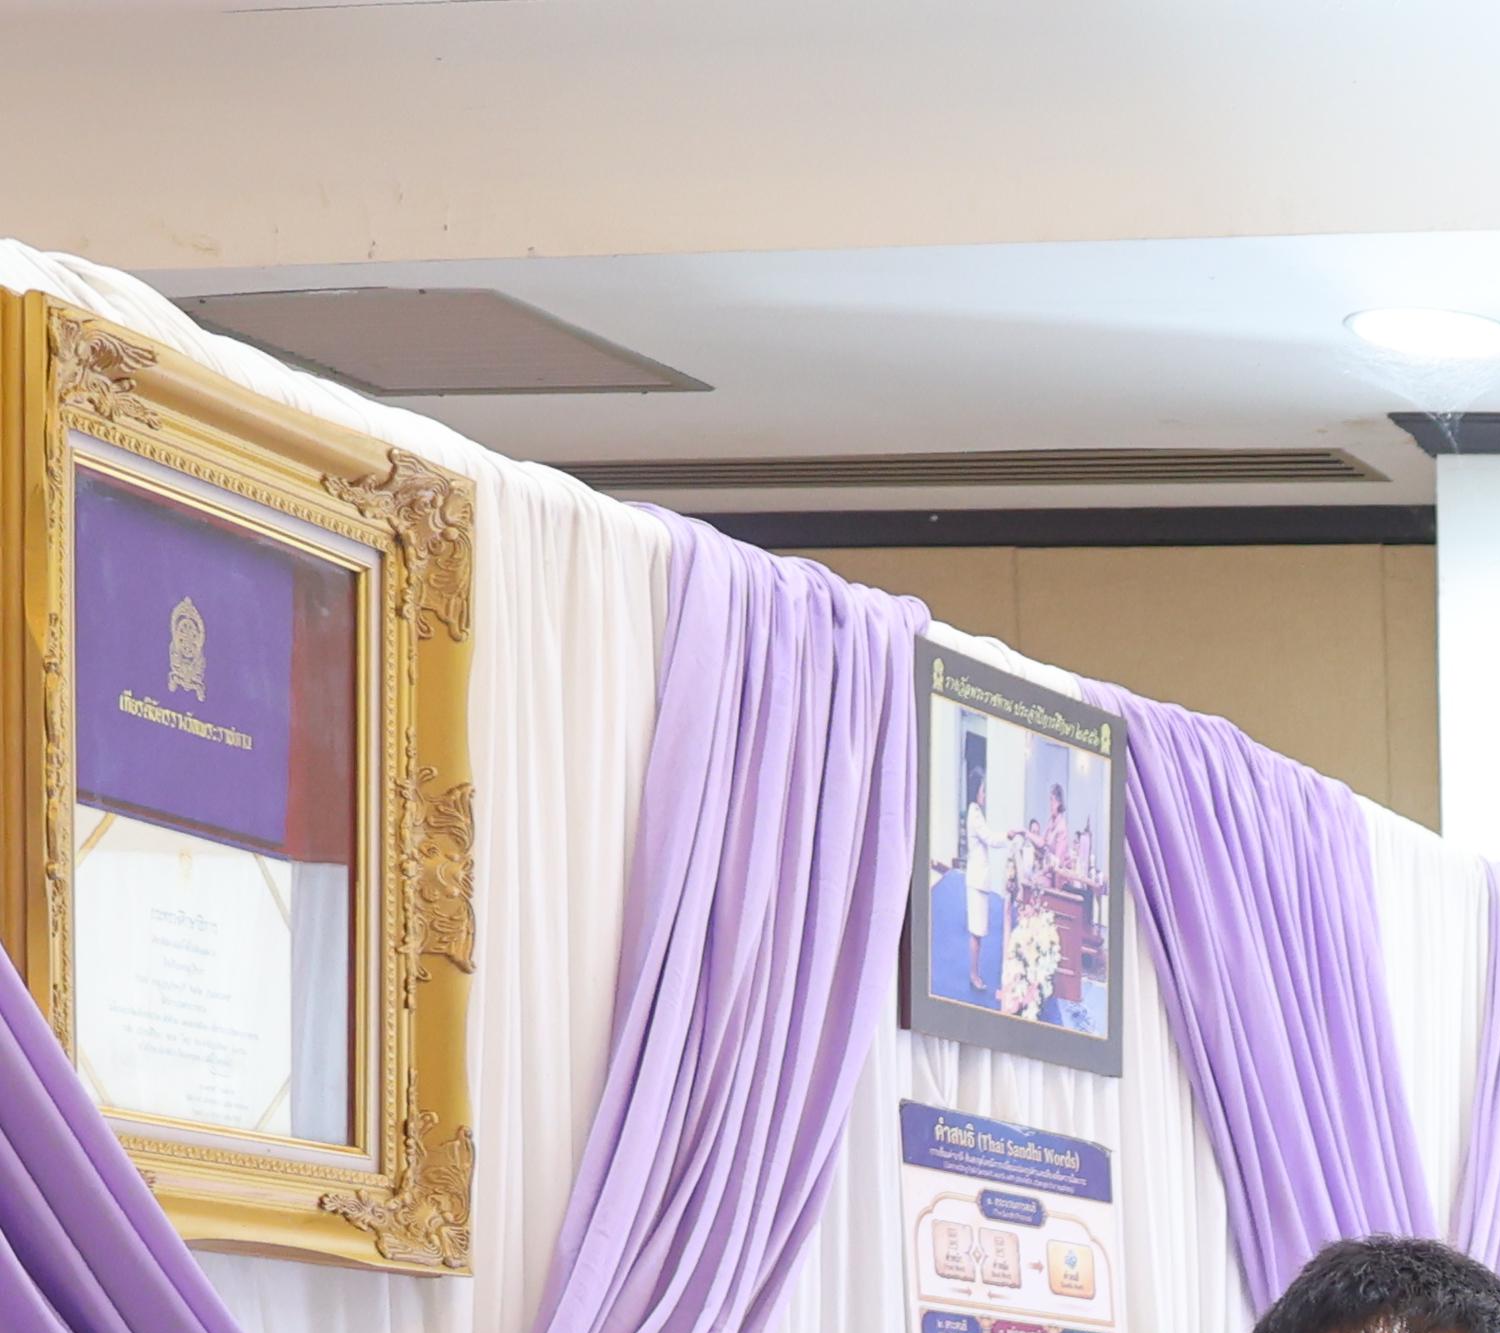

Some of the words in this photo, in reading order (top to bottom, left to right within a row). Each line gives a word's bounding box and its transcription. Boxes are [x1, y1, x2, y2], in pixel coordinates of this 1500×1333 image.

[935, 1117, 975, 1148] คำสนธิ
[978, 1133, 1005, 1153] (Thai
[1007, 1139, 1042, 1163] Sandhi
[1044, 1149, 1080, 1172] Words)
